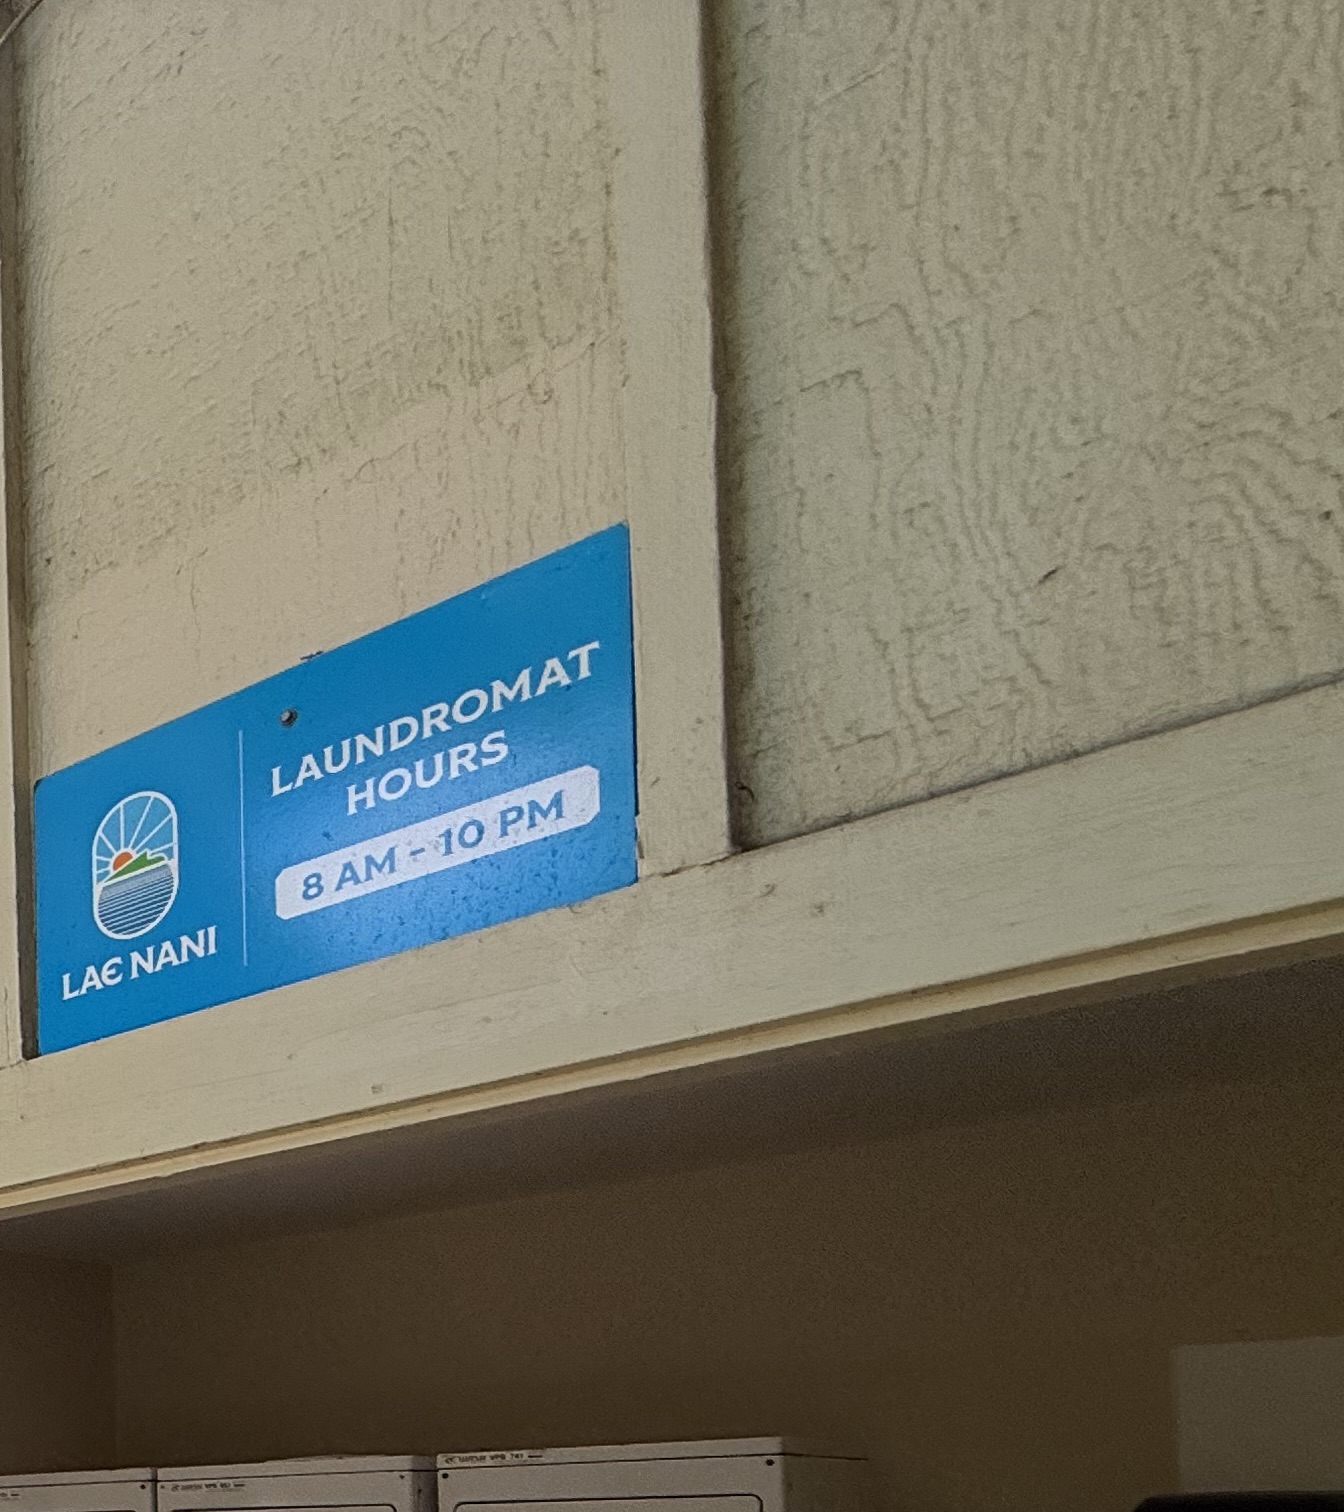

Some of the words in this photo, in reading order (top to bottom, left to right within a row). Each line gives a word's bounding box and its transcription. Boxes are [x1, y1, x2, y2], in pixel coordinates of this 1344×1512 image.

[269, 640, 600, 798] LAUNDROMAT
[346, 729, 510, 816] HOURS
[301, 872, 325, 903] 8
[334, 846, 397, 894] AM
[437, 820, 484, 857] 10
[498, 789, 566, 838] PM
[129, 925, 218, 984] NANI
